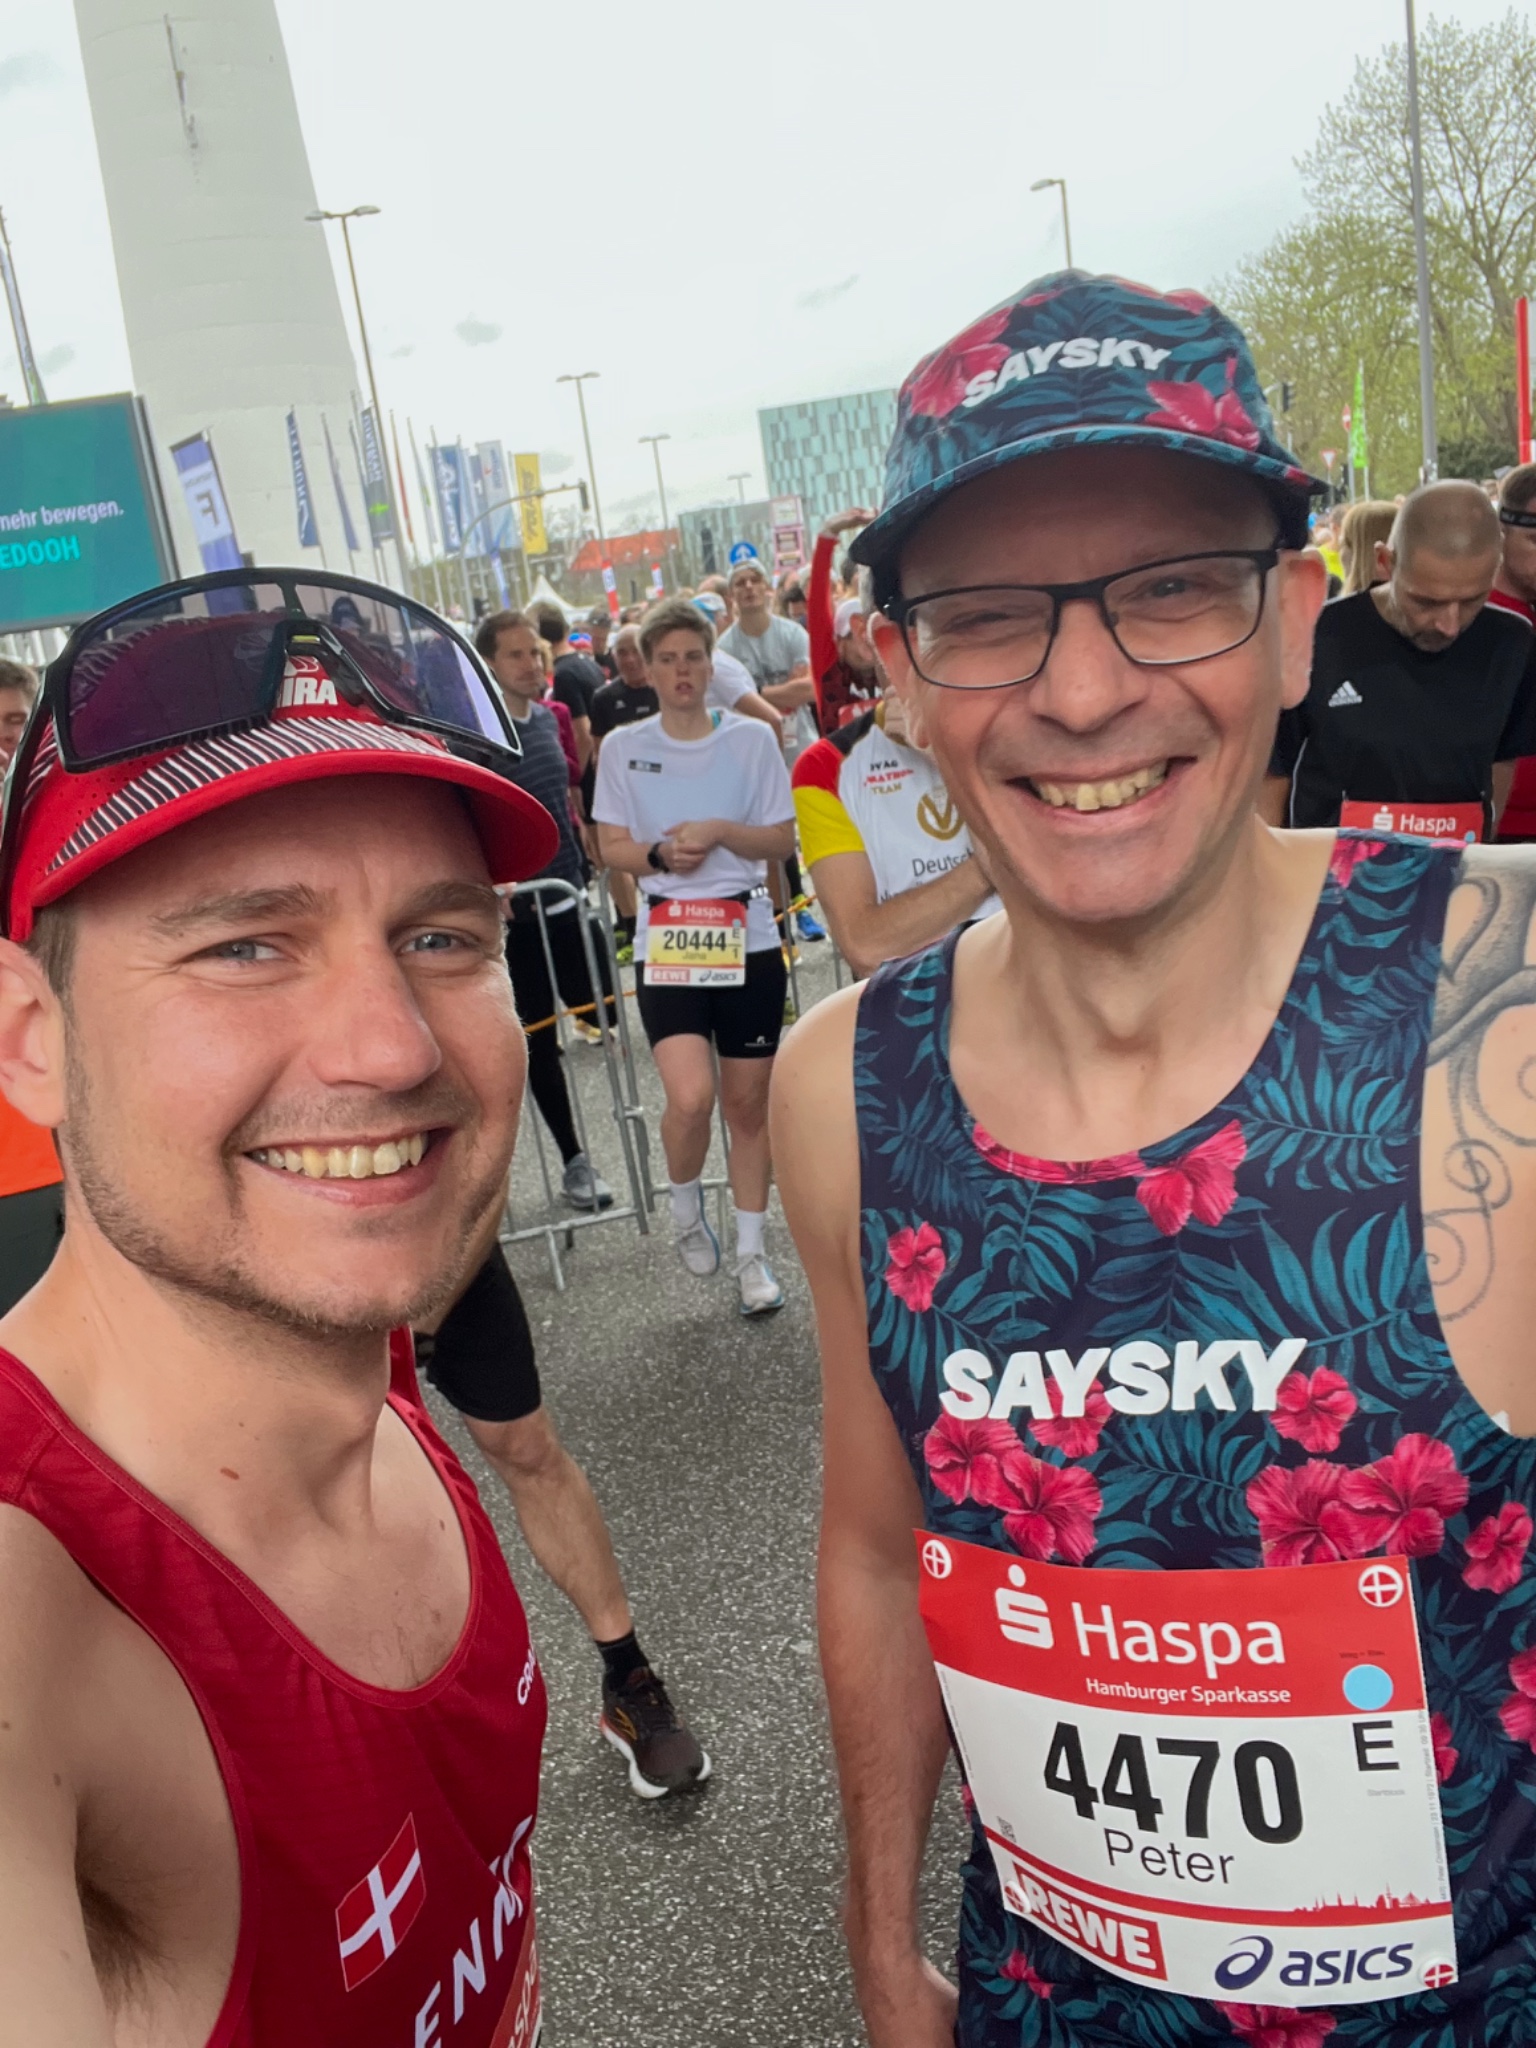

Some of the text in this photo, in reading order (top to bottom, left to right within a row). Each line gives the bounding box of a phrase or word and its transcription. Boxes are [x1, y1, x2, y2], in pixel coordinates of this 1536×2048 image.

[962, 337, 1172, 408] SAYSKY
[40, 500, 124, 525] bewegen.
[277, 677, 338, 708] IRA
[1400, 813, 1457, 837] Haspa
[685, 904, 726, 919] Haspa
[663, 929, 727, 952] 20444
[939, 1338, 1308, 1420] SAYSKY
[1071, 1601, 1286, 1680] Haspa
[1086, 1677, 1292, 1705] Hamburger Sparkasse
[1352, 1720, 1400, 1772] E
[1043, 1720, 1304, 1845] 4470
[1103, 1827, 1235, 1885] Peter
[1021, 1873, 1157, 1970] REWE
[1279, 1942, 1414, 1987] asics
